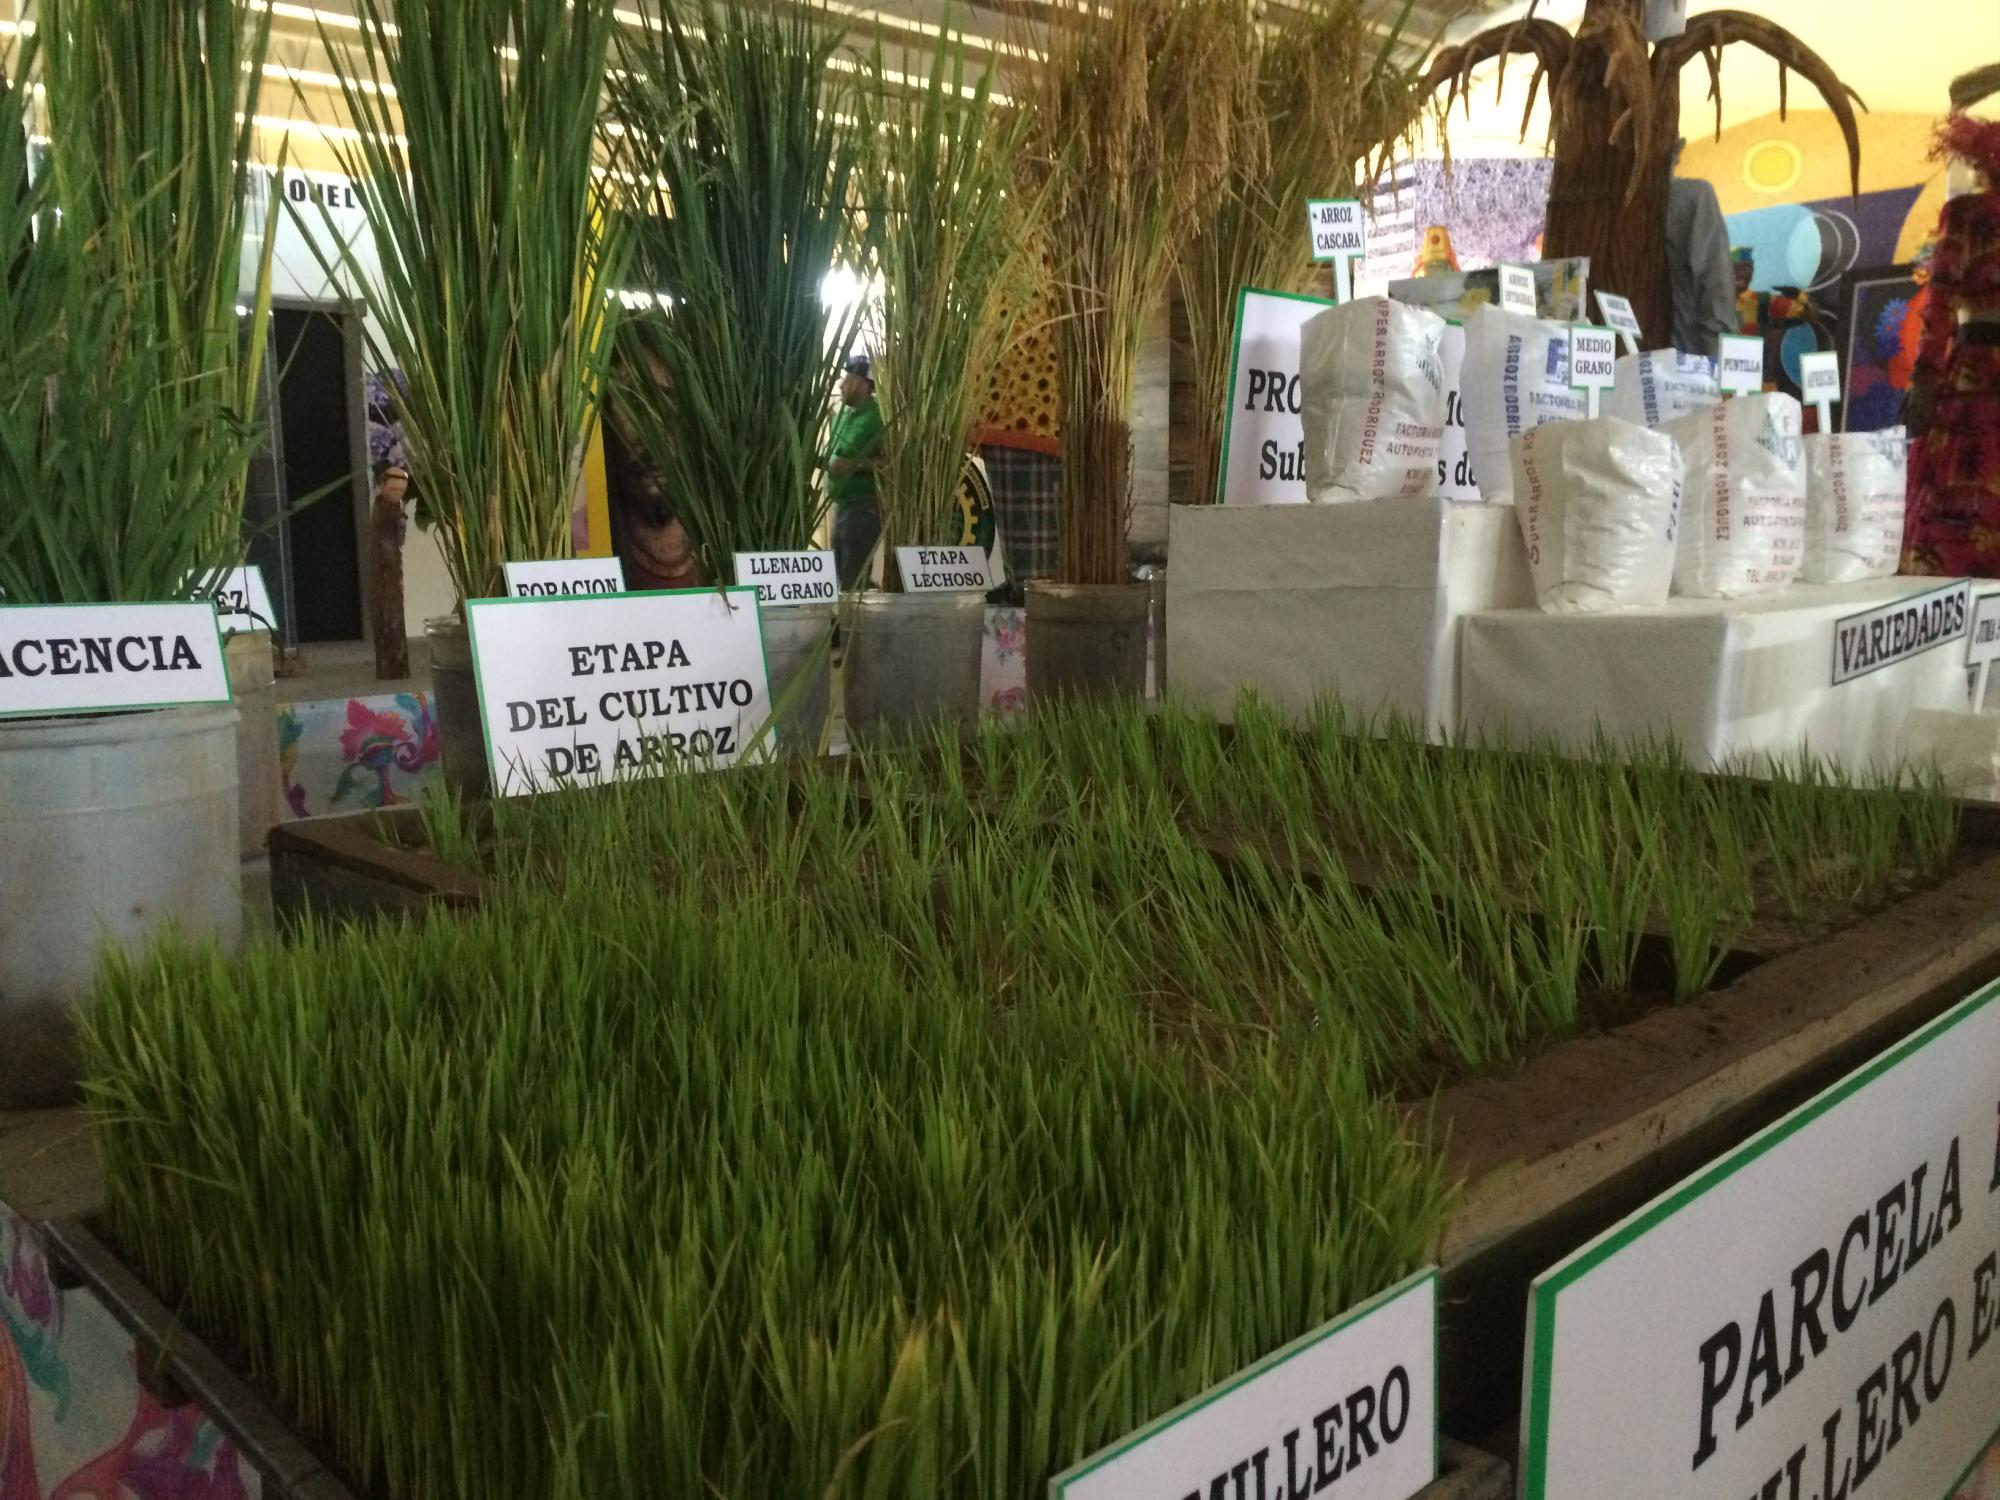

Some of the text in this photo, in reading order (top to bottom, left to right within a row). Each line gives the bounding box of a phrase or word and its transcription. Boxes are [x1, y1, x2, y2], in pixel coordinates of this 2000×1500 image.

[1321, 207, 1353, 223] ARROZ
[1317, 232, 1361, 249] CASCARA
[1372, 341, 1388, 385] ARROZ
[1504, 335, 1522, 381] ARROZ
[1576, 337, 1612, 353] MEDIO
[1575, 360, 1613, 375] GRANO
[1360, 392, 1386, 465] RODRIGUEZ
[1713, 426, 1729, 467] ARROZ
[1523, 459, 1542, 503] ARROZ
[751, 556, 823, 575] LLENADO
[920, 550, 969, 566] ETAPA
[782, 581, 834, 600] GRANO
[912, 572, 984, 588] LECHOSO
[1841, 591, 1965, 674] VARIEDADES
[568, 639, 691, 677] ETAPA
[506, 679, 754, 733] DEL CULTIVO
[545, 726, 736, 779] DE ARROZ
[1692, 1136, 1963, 1472] PARCELA
